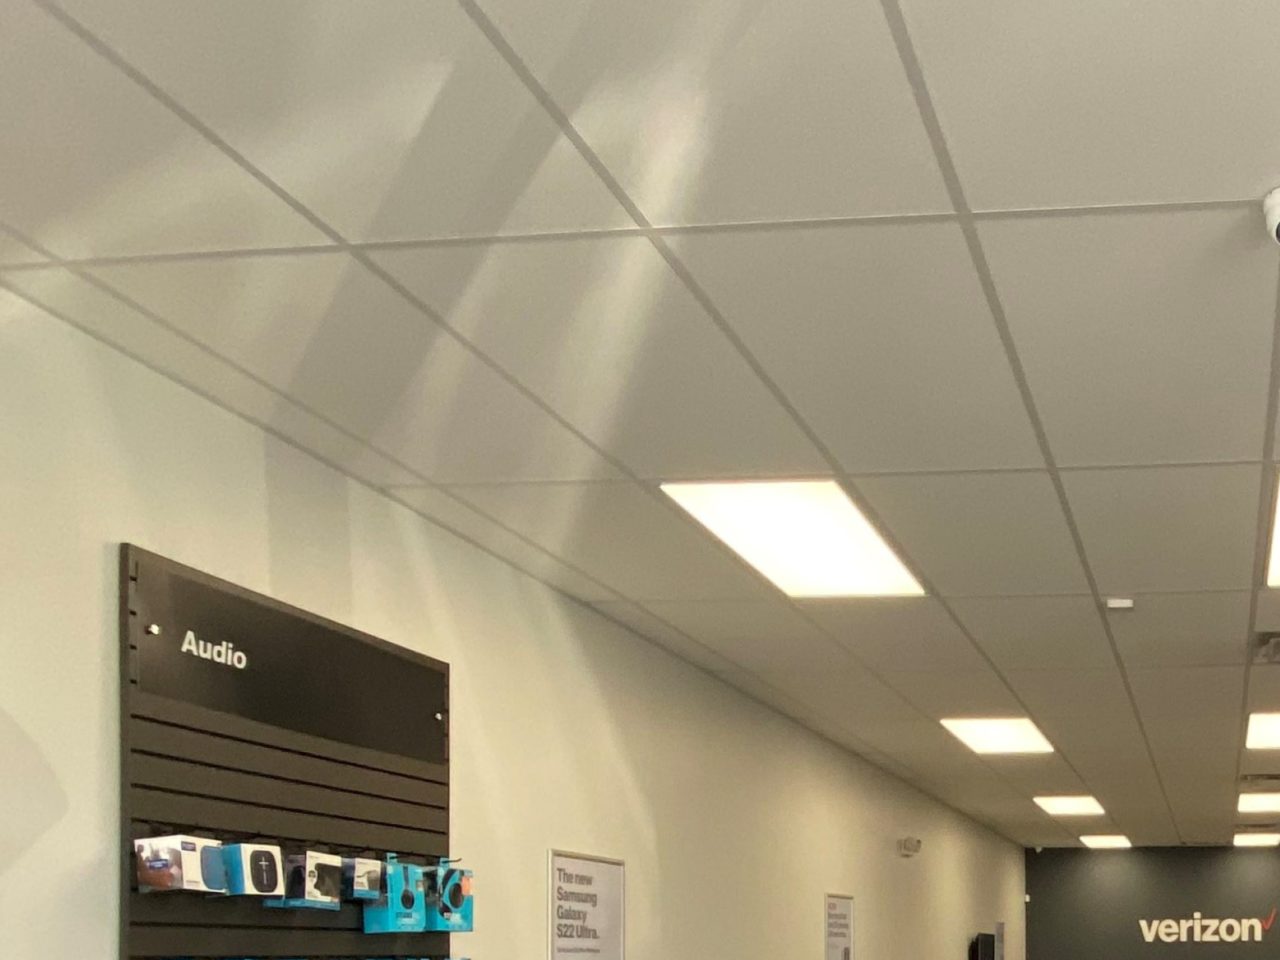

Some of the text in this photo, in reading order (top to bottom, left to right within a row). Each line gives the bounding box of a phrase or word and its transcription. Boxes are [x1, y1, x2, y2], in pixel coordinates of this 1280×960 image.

[181, 629, 247, 669] Audio
[557, 867, 593, 886] The new
[557, 886, 597, 907] Samsung
[556, 904, 587, 924] Galaxy
[557, 923, 575, 938] S22
[1138, 911, 1263, 943] verizon
